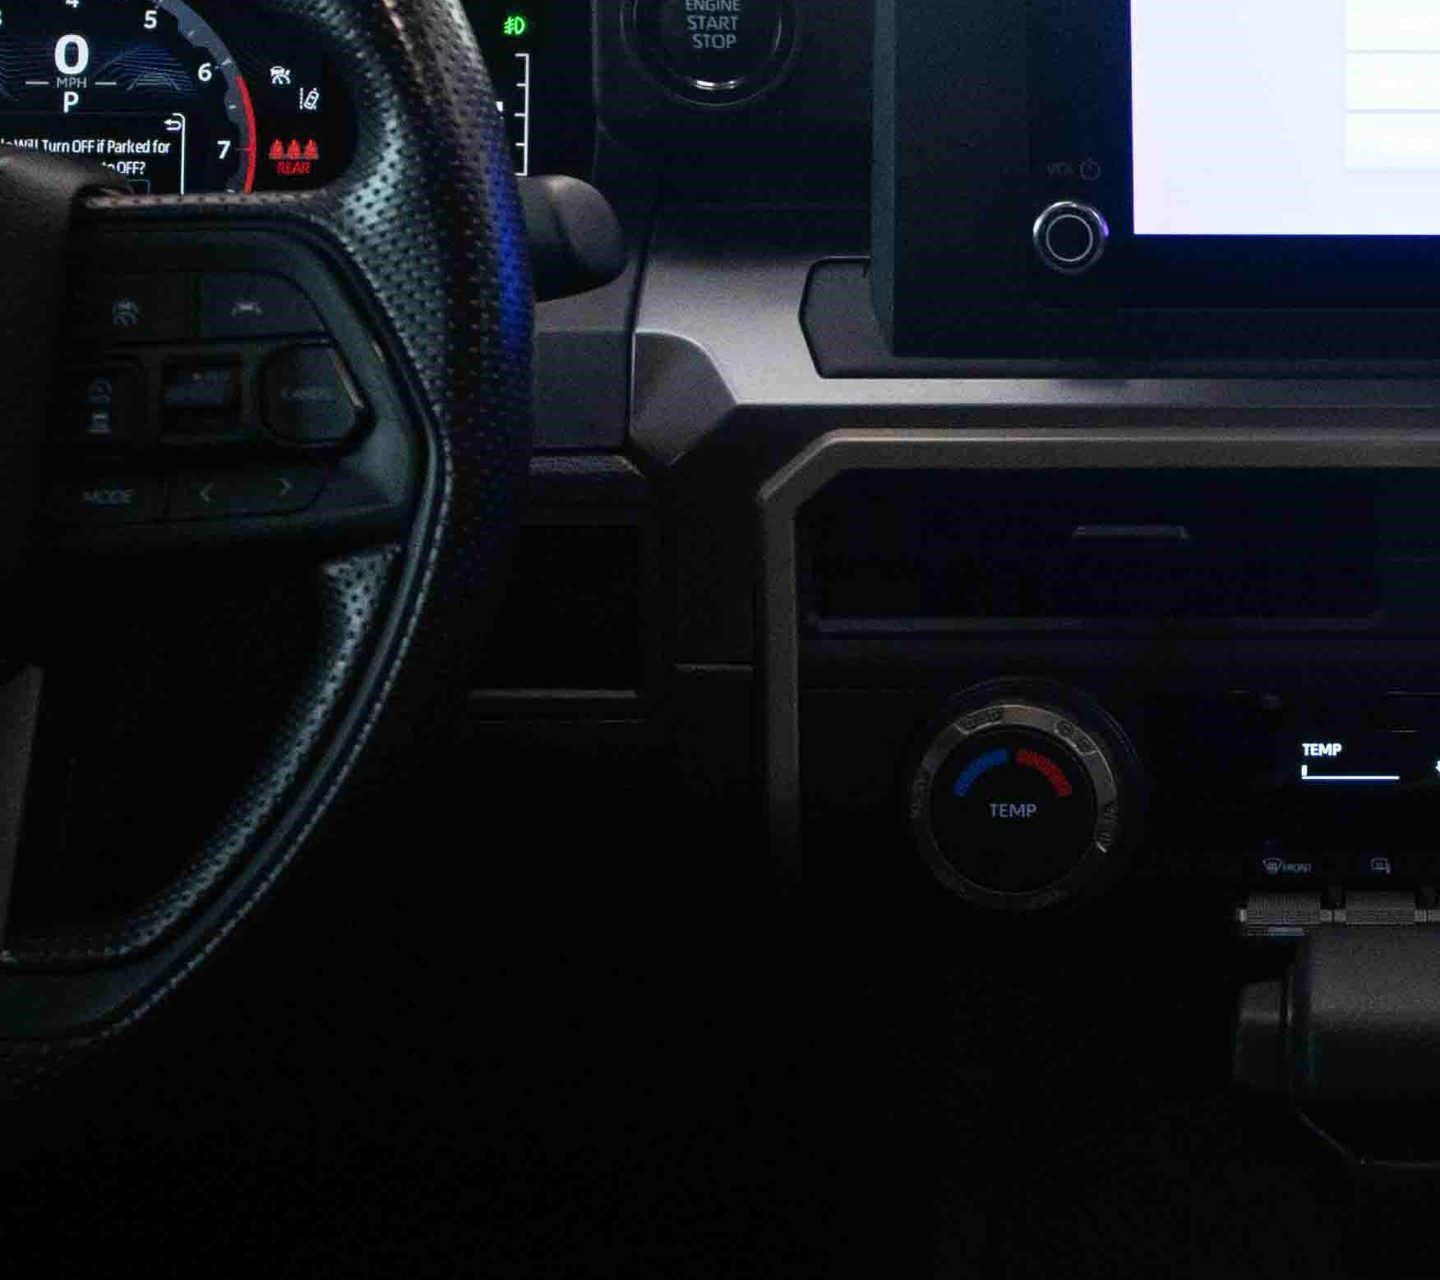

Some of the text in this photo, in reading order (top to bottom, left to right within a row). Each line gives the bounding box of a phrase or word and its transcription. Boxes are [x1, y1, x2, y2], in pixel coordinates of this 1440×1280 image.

[143, 9, 158, 30] 5
[686, 15, 739, 31] START
[692, 33, 737, 49] STOP
[197, 62, 213, 82] 6
[56, 76, 87, 89] MPH
[63, 91, 79, 114] P
[42, 139, 69, 153] Turn
[72, 139, 94, 154] OFF
[96, 139, 105, 153] if
[107, 139, 151, 154] Parked
[153, 139, 170, 154] for
[217, 140, 231, 160] 7
[116, 161, 146, 176] OFF?
[277, 161, 311, 175] REAR
[1301, 742, 1342, 757] TEMP
[989, 802, 1037, 819] TEMP
